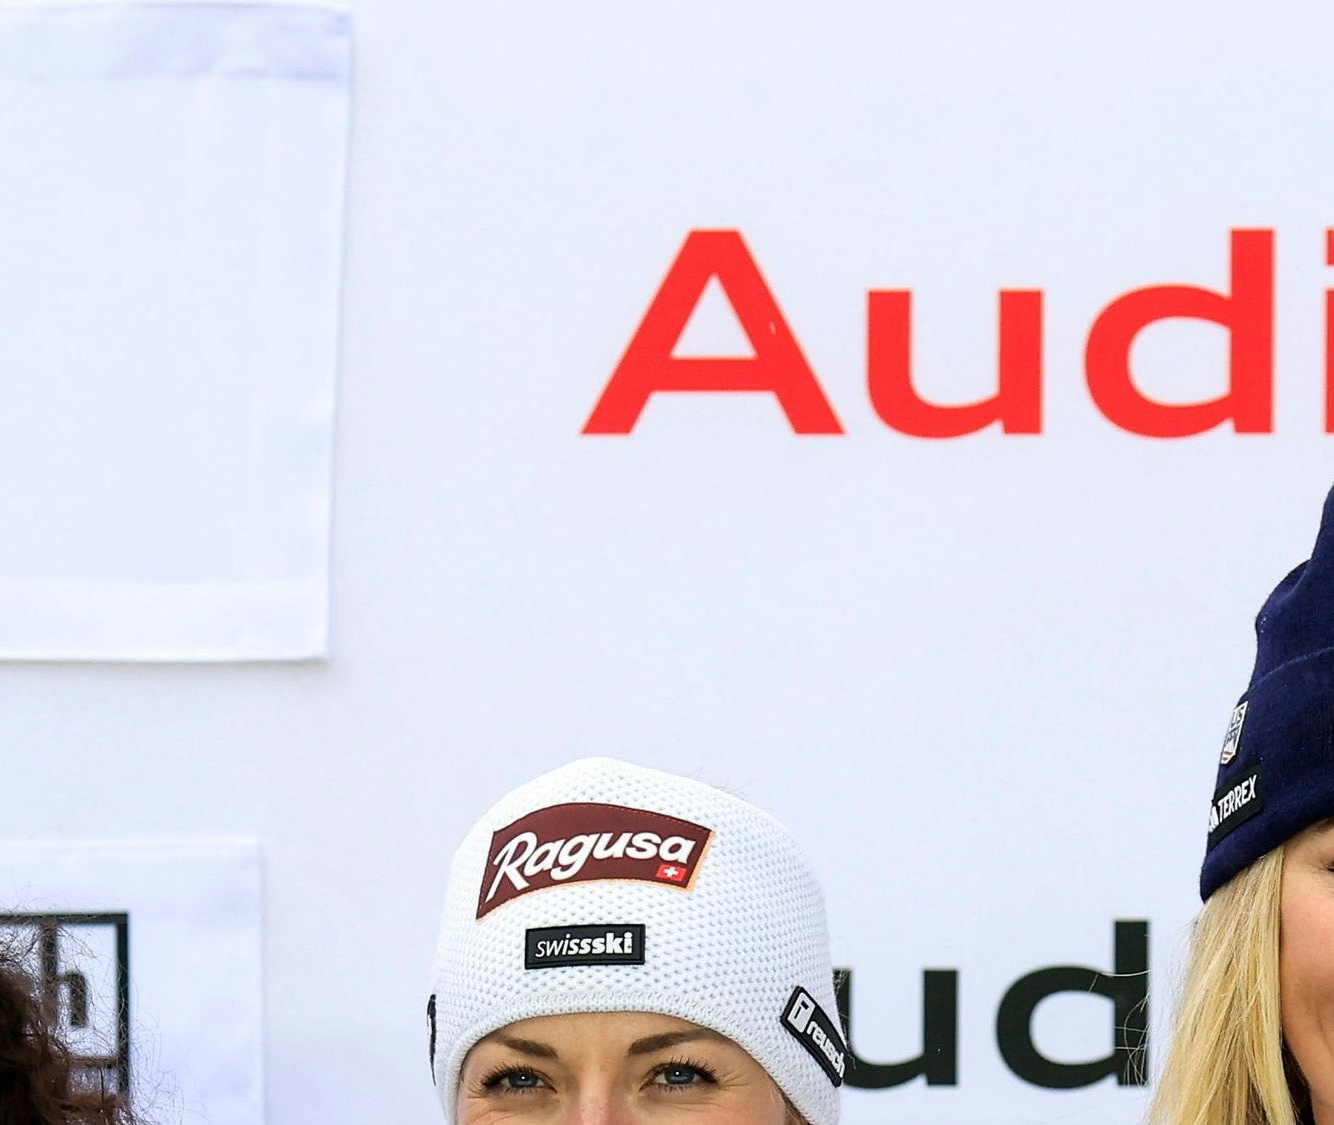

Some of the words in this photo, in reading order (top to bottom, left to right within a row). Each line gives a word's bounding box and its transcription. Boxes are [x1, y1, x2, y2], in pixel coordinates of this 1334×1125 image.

[1217, 774, 1257, 823] TERREX
[484, 831, 695, 903] Ragusa
[832, 919, 1149, 1090] ud
[806, 1020, 846, 1079] reusch
